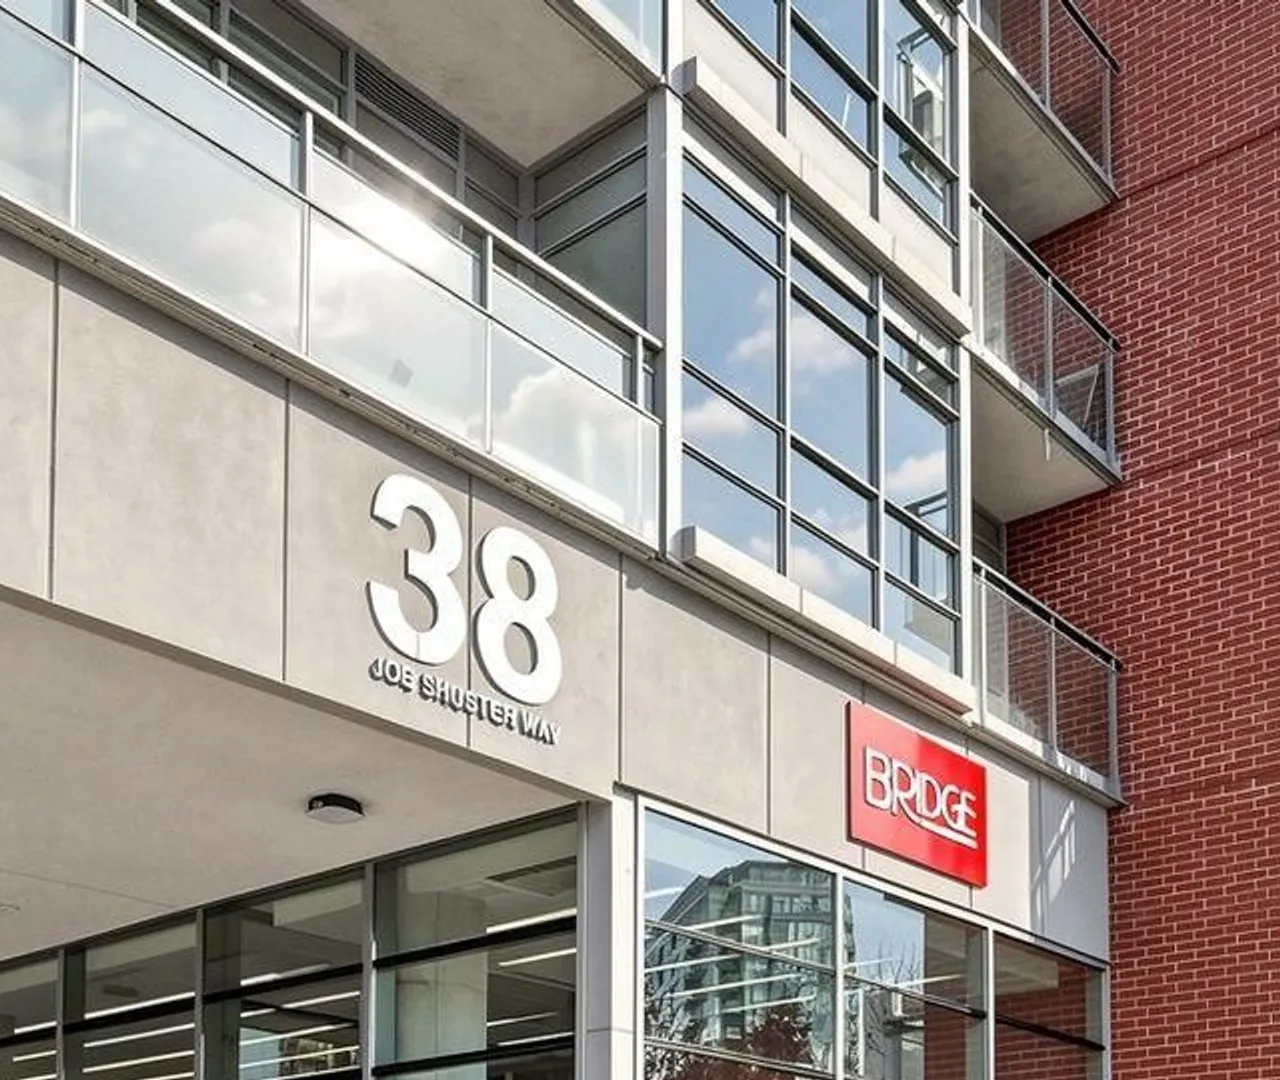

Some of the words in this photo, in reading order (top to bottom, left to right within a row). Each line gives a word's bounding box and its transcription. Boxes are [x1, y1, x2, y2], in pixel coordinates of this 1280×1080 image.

[366, 473, 562, 706] 38
[517, 708, 561, 745] WAY
[864, 744, 978, 849] BRIDGE
